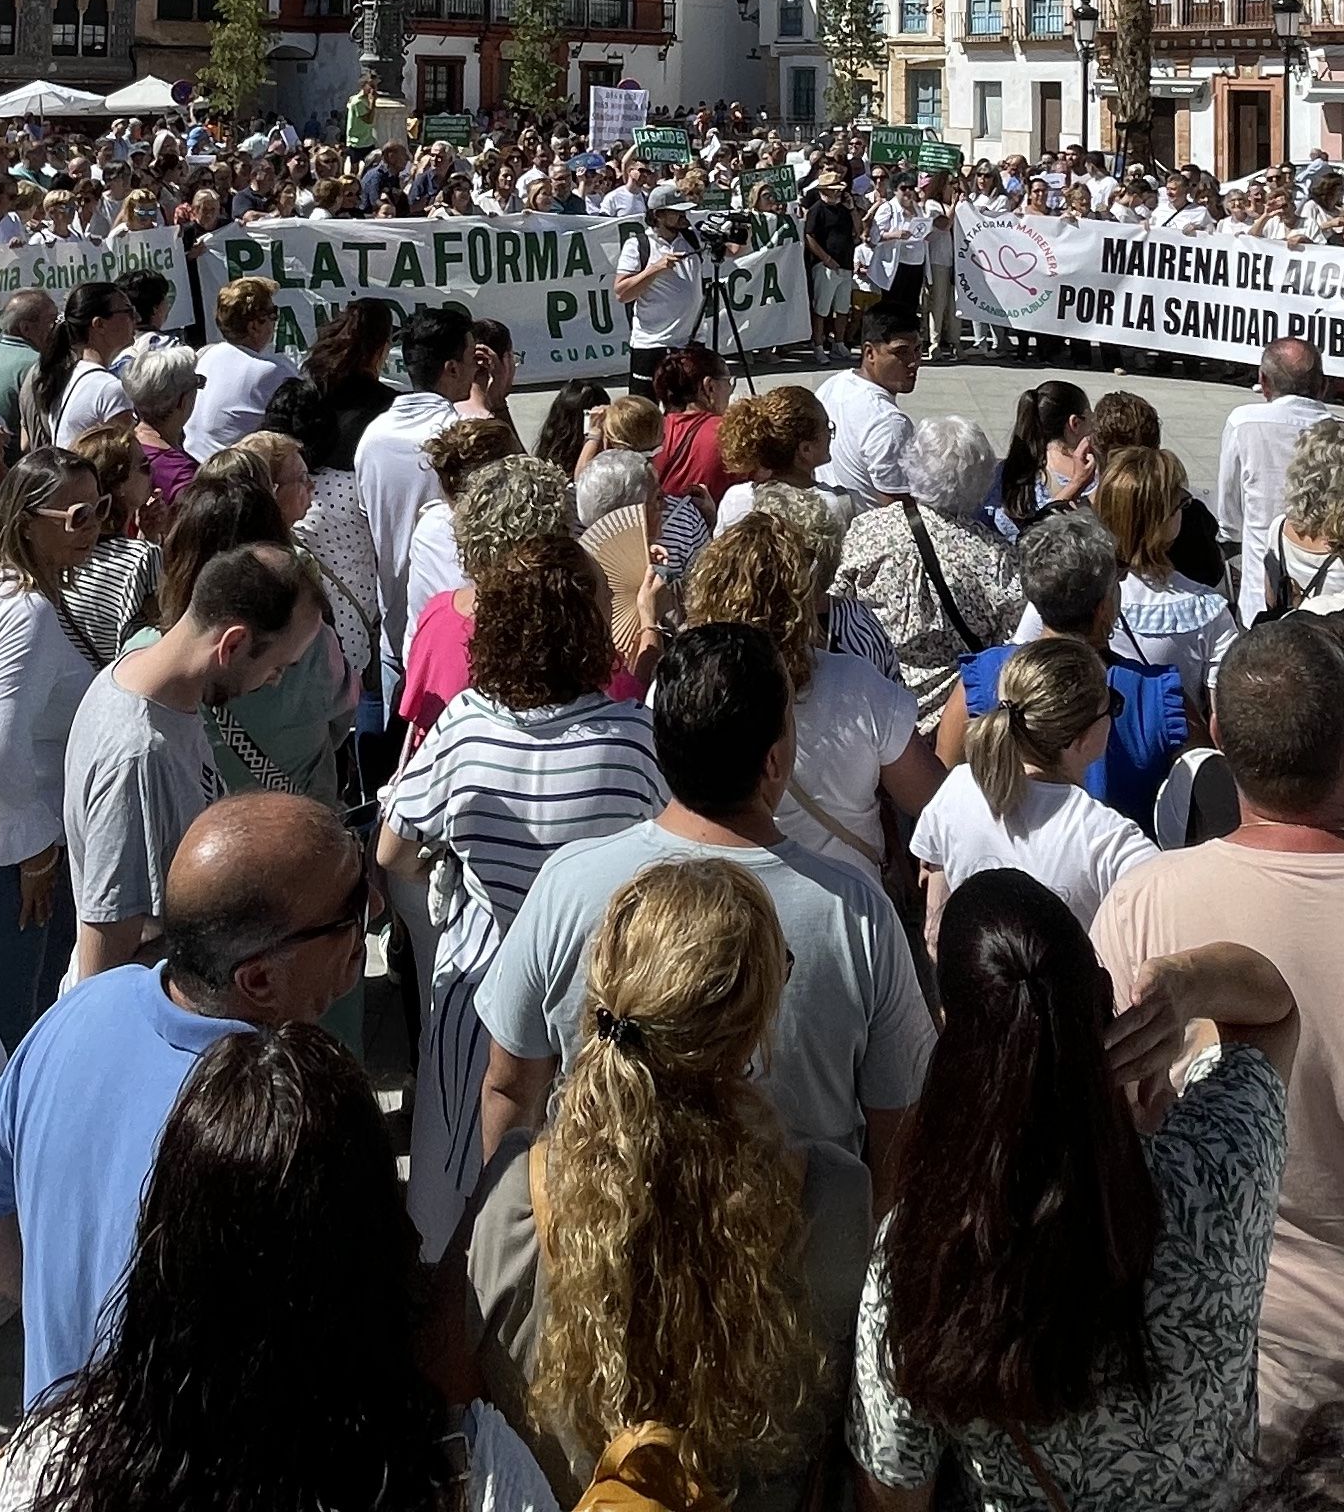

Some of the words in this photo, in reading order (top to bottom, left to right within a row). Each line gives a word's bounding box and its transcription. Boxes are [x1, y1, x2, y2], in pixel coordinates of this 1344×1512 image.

[32, 253, 98, 289] Sanida
[224, 226, 594, 289] PLATAFORMA
[958, 221, 1014, 259] PLATAFORMA
[1016, 223, 1059, 278] MAIRENERA
[1101, 237, 1229, 288] MAIRENA
[1236, 251, 1274, 291] DEL
[958, 273, 968, 293] POR
[967, 291, 979, 305] LA
[978, 301, 1020, 318] SANIDAD
[1057, 284, 1115, 326] POR
[1122, 292, 1156, 332] LA
[1163, 296, 1278, 348] SANIDAD
